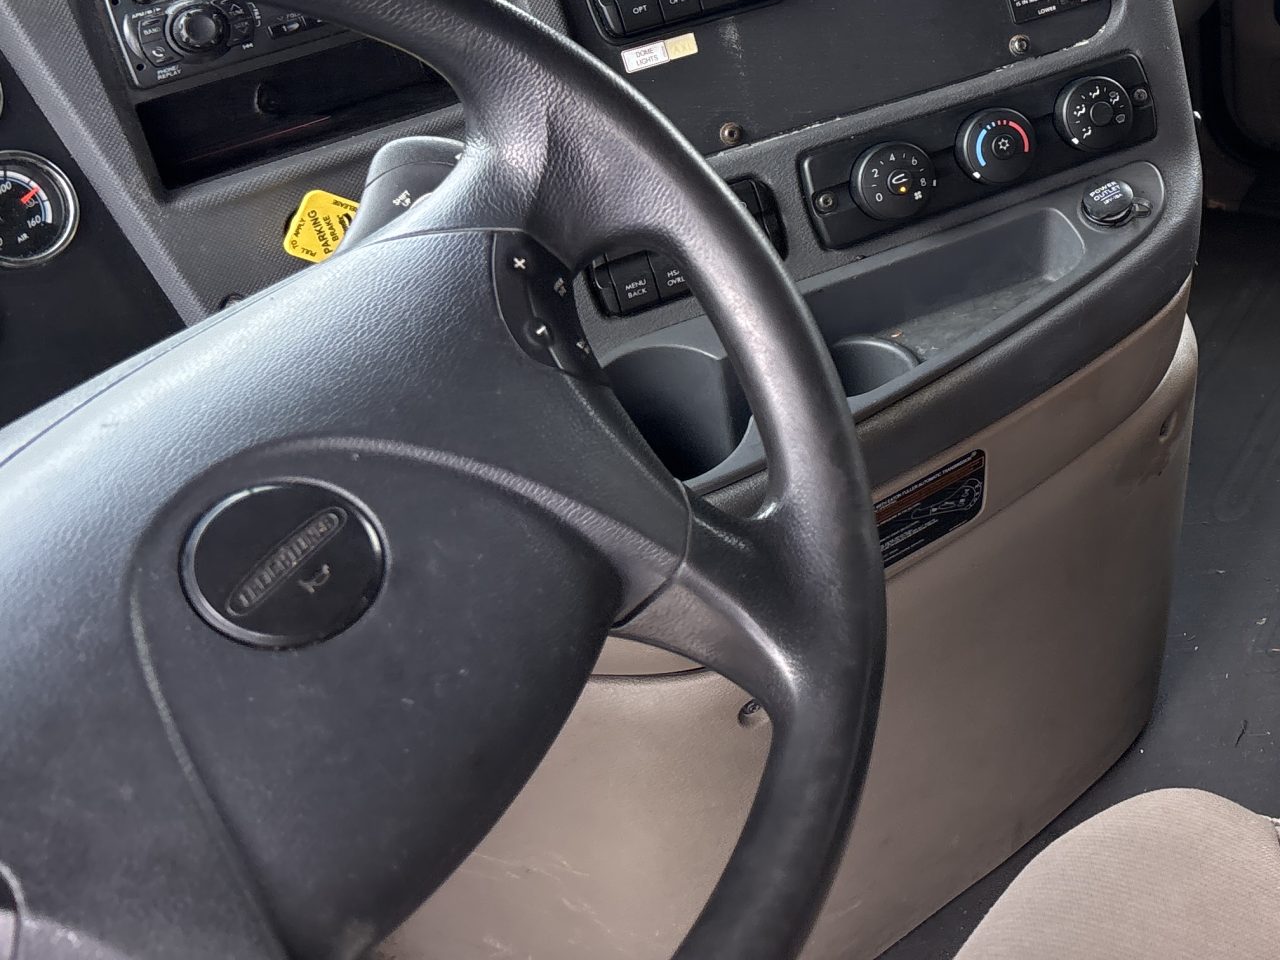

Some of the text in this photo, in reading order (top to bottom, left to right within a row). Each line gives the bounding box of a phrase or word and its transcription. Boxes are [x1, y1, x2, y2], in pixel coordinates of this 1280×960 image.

[632, 4, 648, 15] OPT
[1037, 5, 1057, 15] LOWER
[635, 48, 654, 58] DOME
[636, 54, 659, 66] LIGHTS
[889, 152, 896, 162] 4
[911, 155, 918, 166] 6
[871, 168, 880, 178] 2
[920, 177, 927, 187] 8
[1089, 181, 1118, 198] POWER
[1093, 184, 1121, 202] OUTLET
[400, 197, 411, 207] UP
[875, 192, 883, 202] 0
[27, 215, 42, 229] 160
[294, 217, 305, 238] APPLY
[307, 209, 334, 255] PARKING
[322, 214, 340, 242] BRAKE
[17, 233, 30, 244] AIR
[290, 239, 299, 250] TO
[625, 278, 647, 291] MENU
[627, 287, 648, 299] BACK
